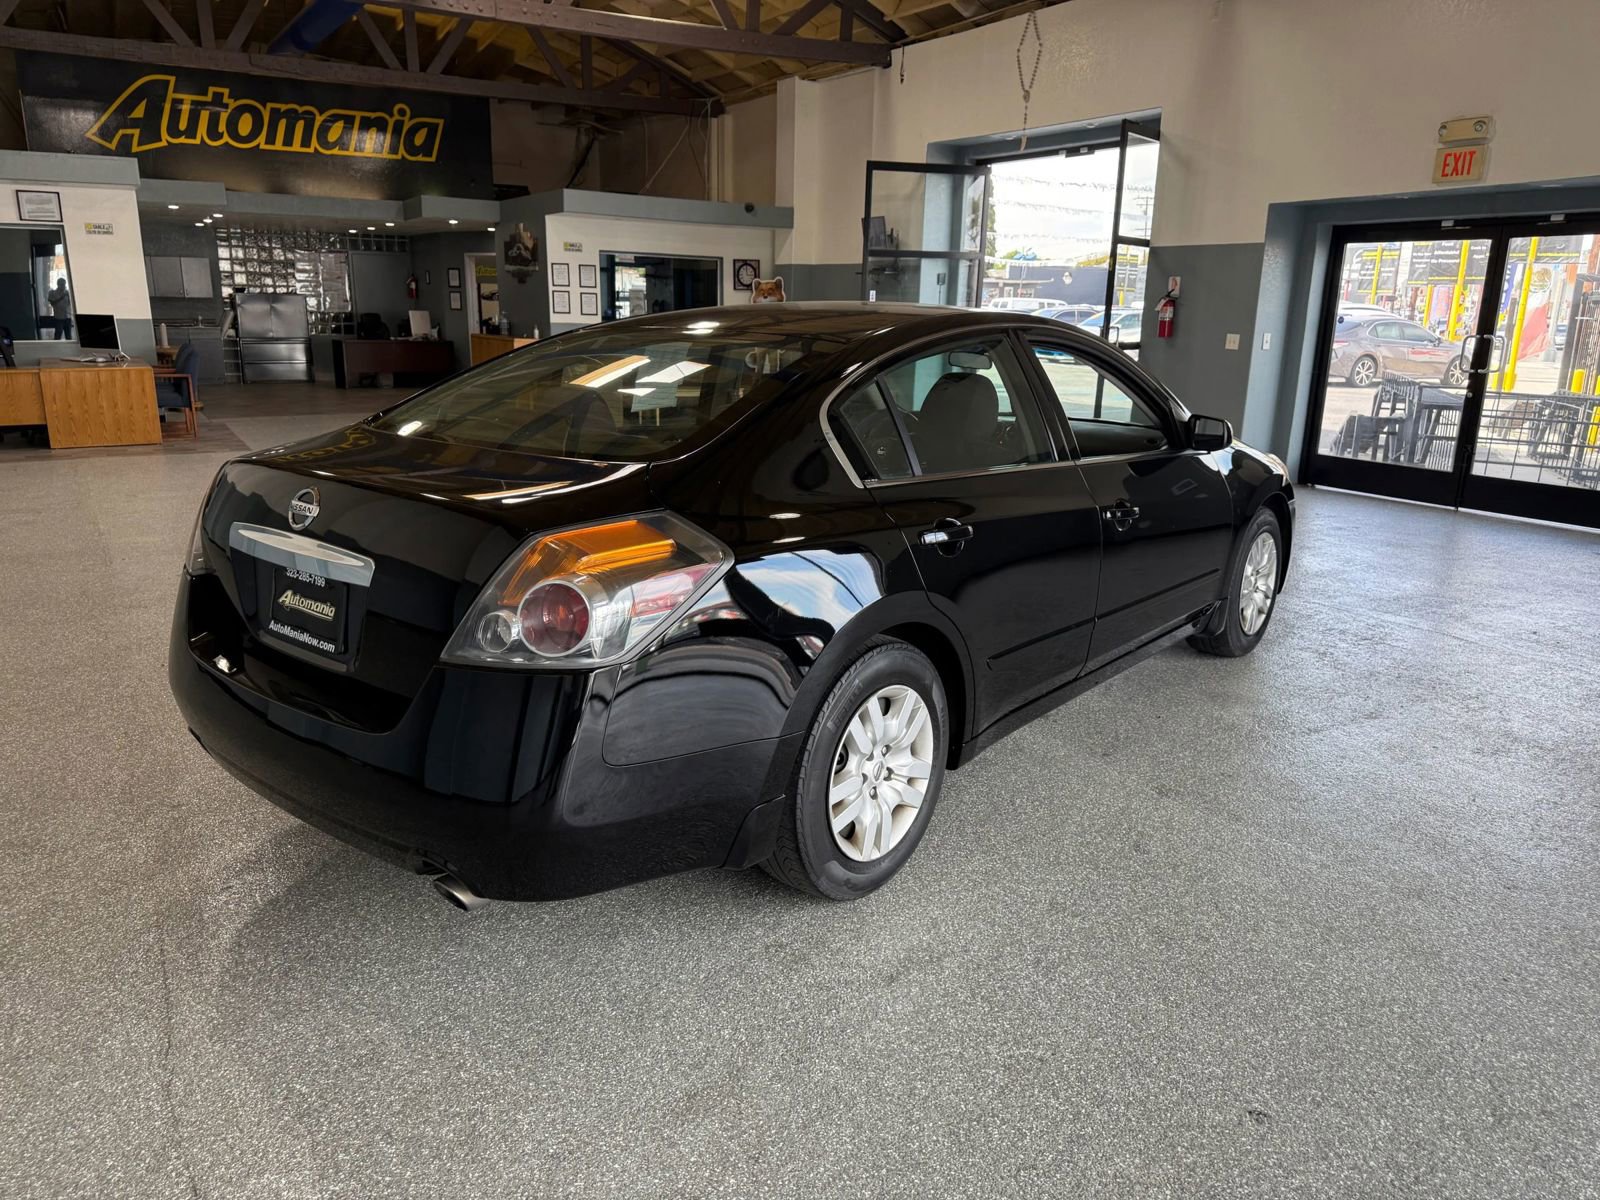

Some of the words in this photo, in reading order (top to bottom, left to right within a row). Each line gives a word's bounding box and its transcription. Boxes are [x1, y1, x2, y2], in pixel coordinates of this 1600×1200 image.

[85, 74, 445, 162] Automania
[1441, 150, 1477, 178] EXIT
[286, 567, 326, 588] 323-285-7199
[278, 589, 336, 618] Automania
[268, 620, 336, 653] AutoManiaNow.com
